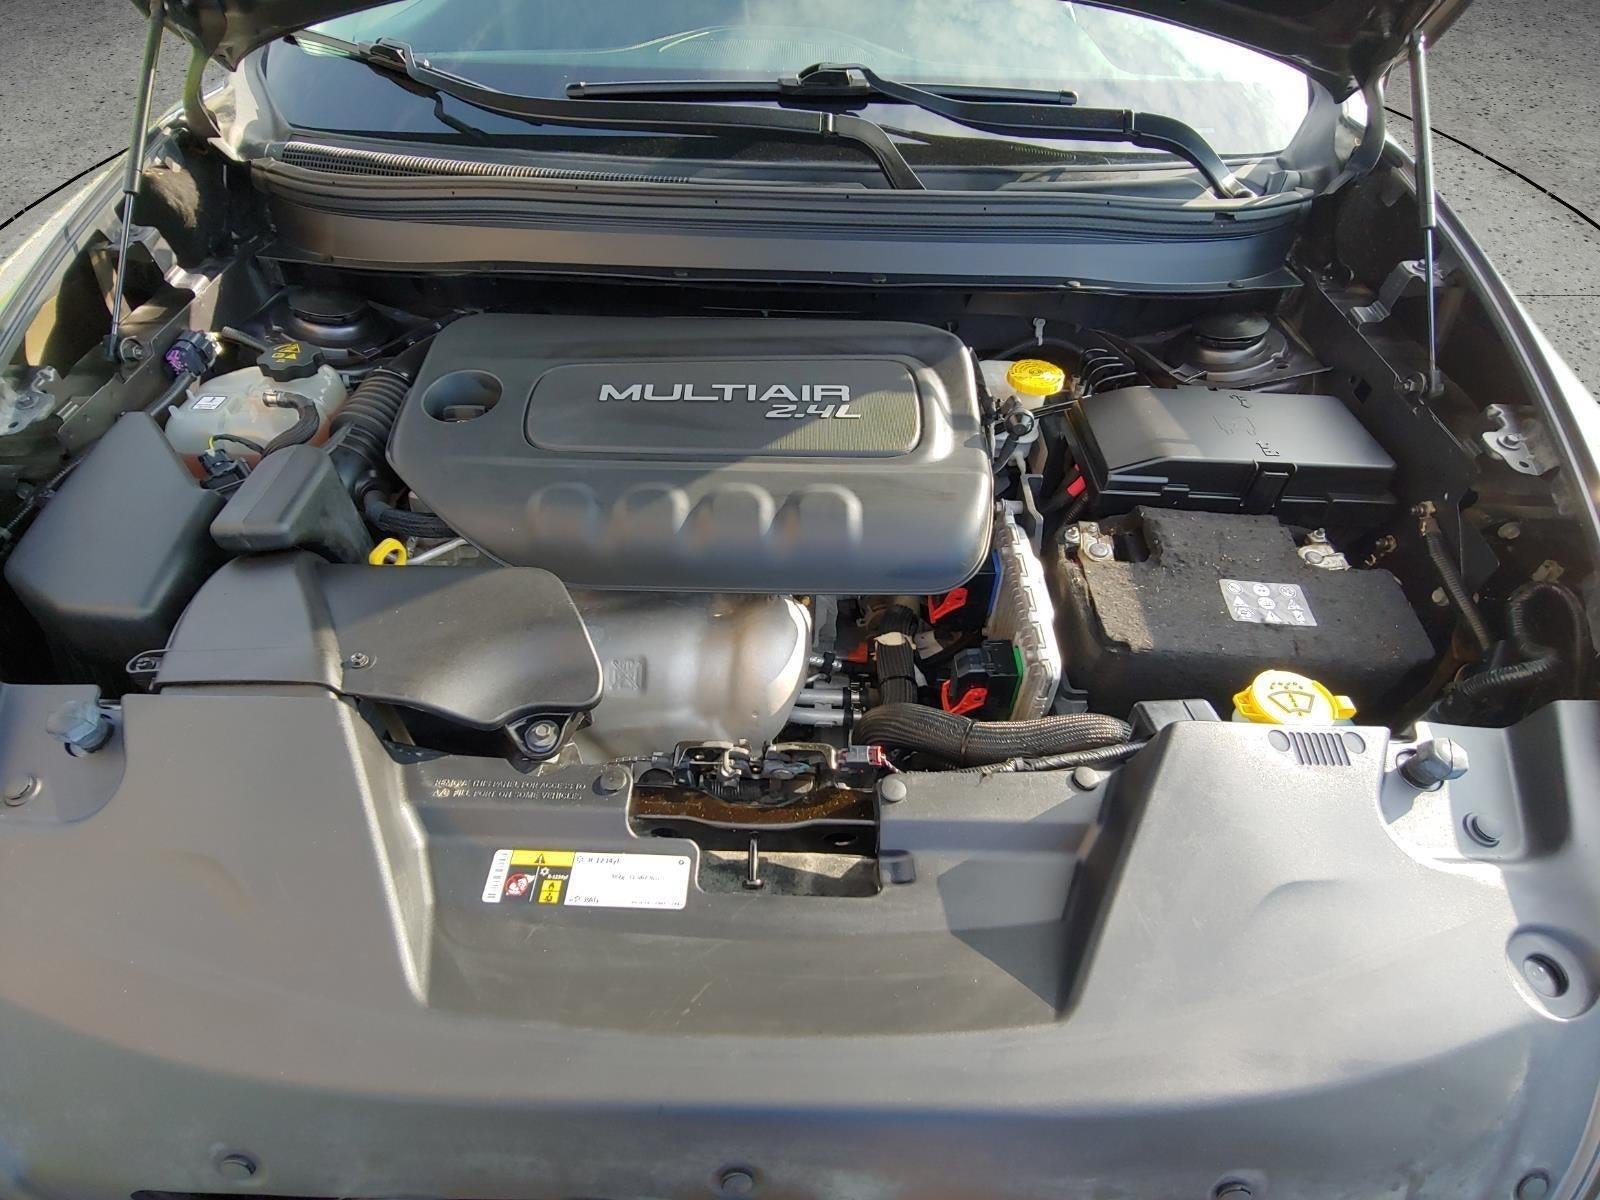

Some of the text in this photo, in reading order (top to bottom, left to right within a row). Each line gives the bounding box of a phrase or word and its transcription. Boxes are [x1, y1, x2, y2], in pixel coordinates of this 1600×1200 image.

[599, 384, 850, 401] MULTIAIR
[765, 404, 861, 418] 2.4L
[493, 780, 519, 788] PANEL
[521, 781, 538, 789] FOR
[498, 791, 512, 799] ON
